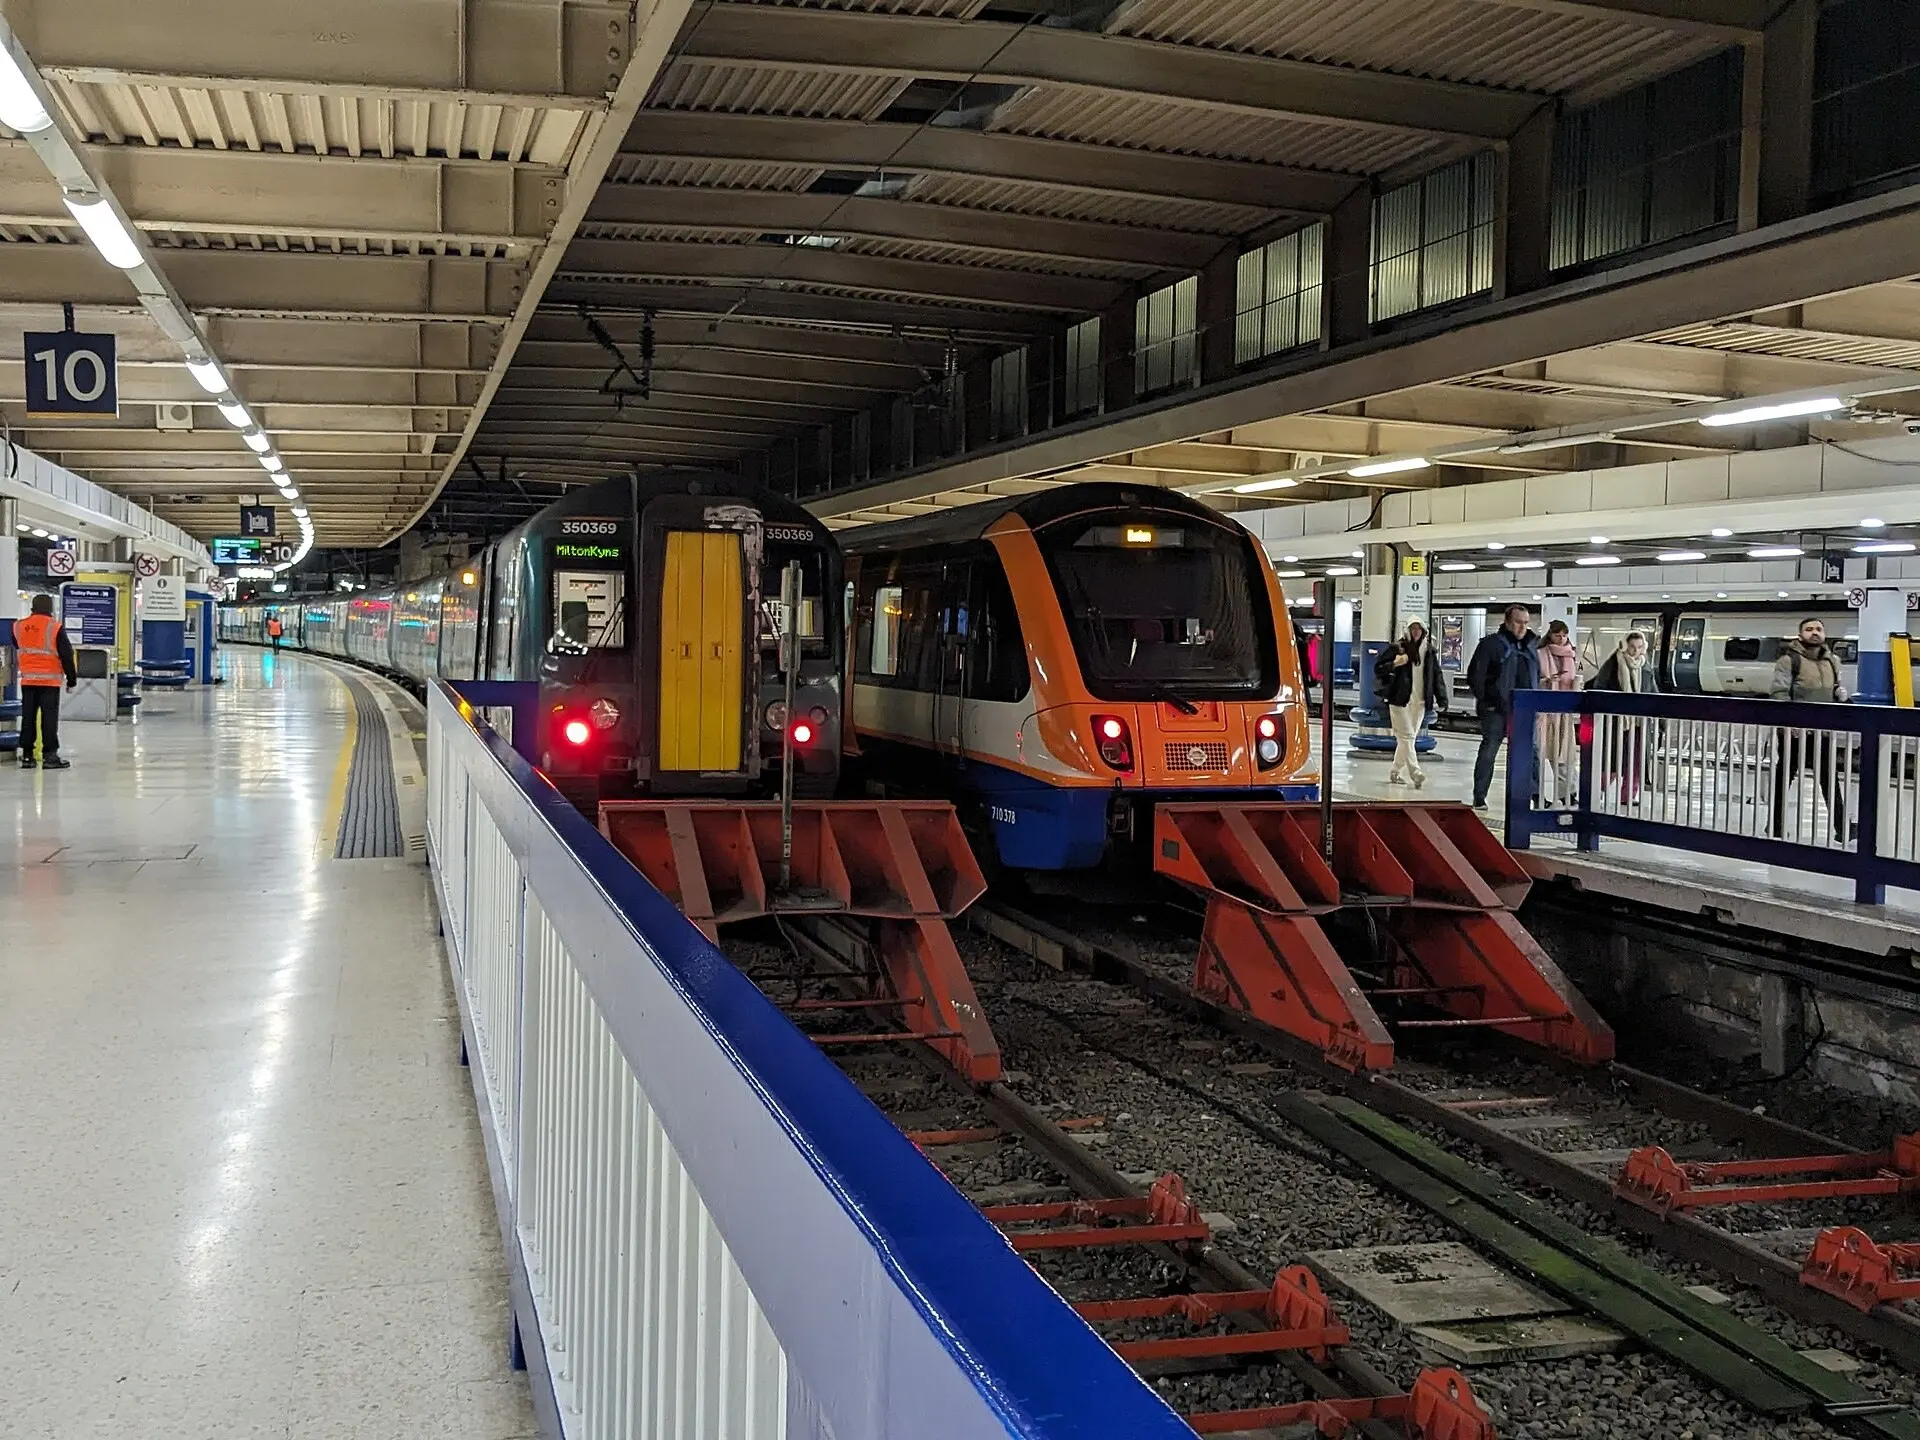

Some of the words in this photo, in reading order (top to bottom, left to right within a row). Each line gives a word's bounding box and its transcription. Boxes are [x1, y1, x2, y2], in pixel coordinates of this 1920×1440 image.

[33, 349, 107, 402] 10
[562, 521, 617, 534] 350369
[766, 528, 814, 541] 350369
[273, 546, 292, 561] 10
[556, 545, 619, 558] MiltonKyns
[1411, 561, 1419, 571] E
